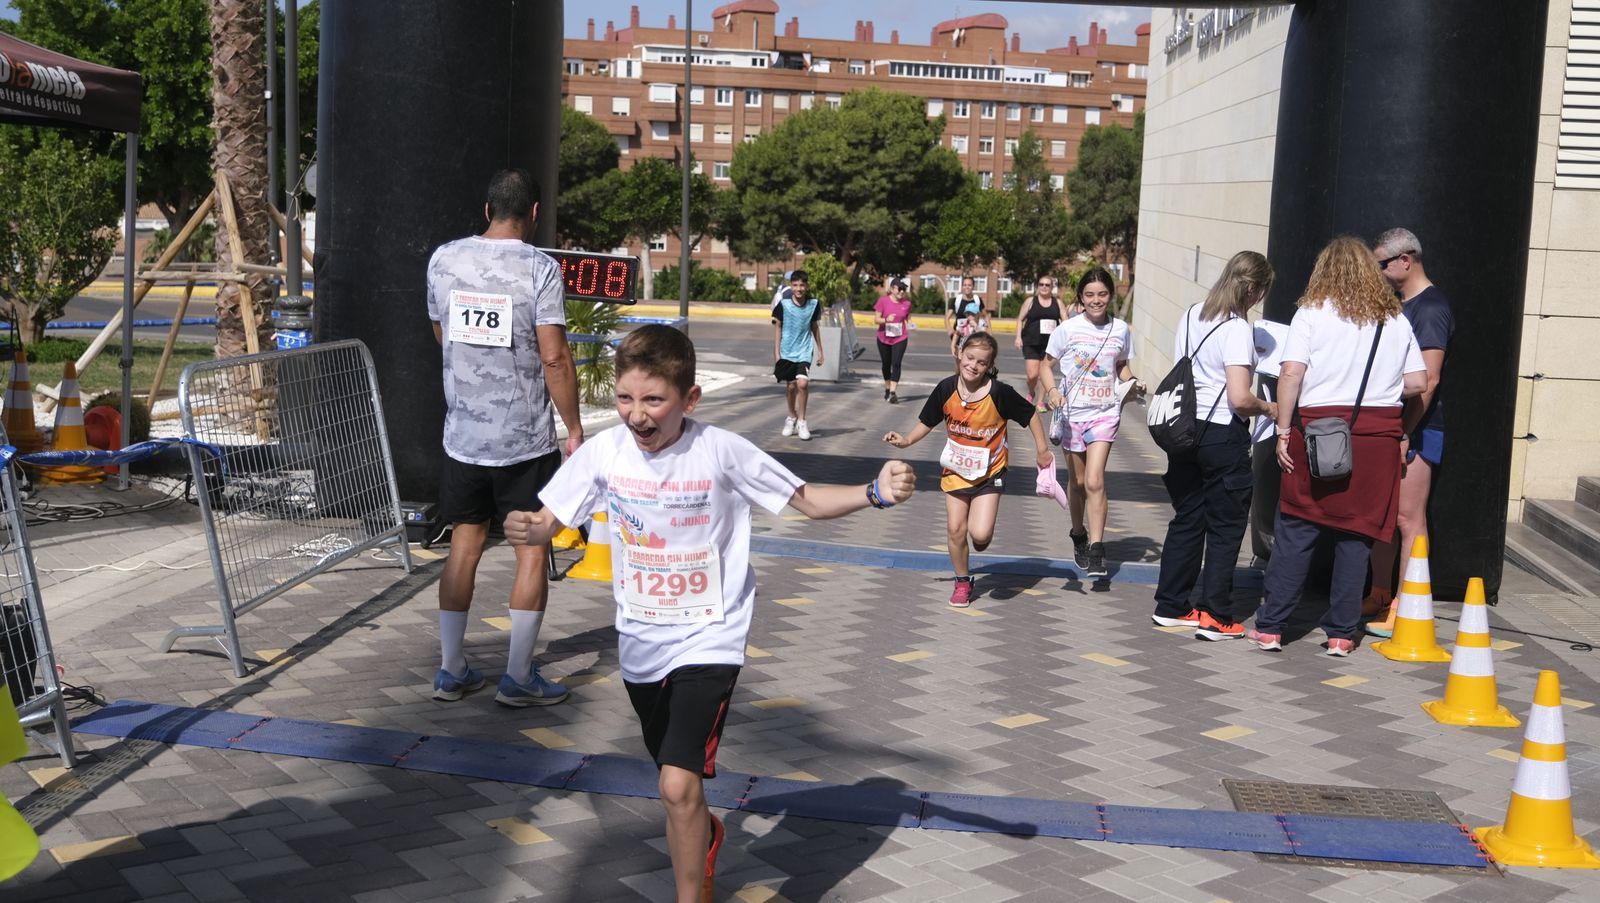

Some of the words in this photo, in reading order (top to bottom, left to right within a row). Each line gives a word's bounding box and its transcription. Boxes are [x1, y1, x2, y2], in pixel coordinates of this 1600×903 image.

[34, 94, 82, 116] deportivo
[461, 308, 500, 329] 178
[1079, 386, 1111, 398] 1300
[949, 423, 972, 436] CABO
[948, 451, 982, 470] 1301
[682, 479, 712, 492] HUMO
[670, 516, 677, 528] 4
[680, 515, 711, 527] JUNIO
[632, 551, 666, 563] CARRERA
[684, 551, 708, 562] HUMO
[632, 570, 709, 597] 1299
